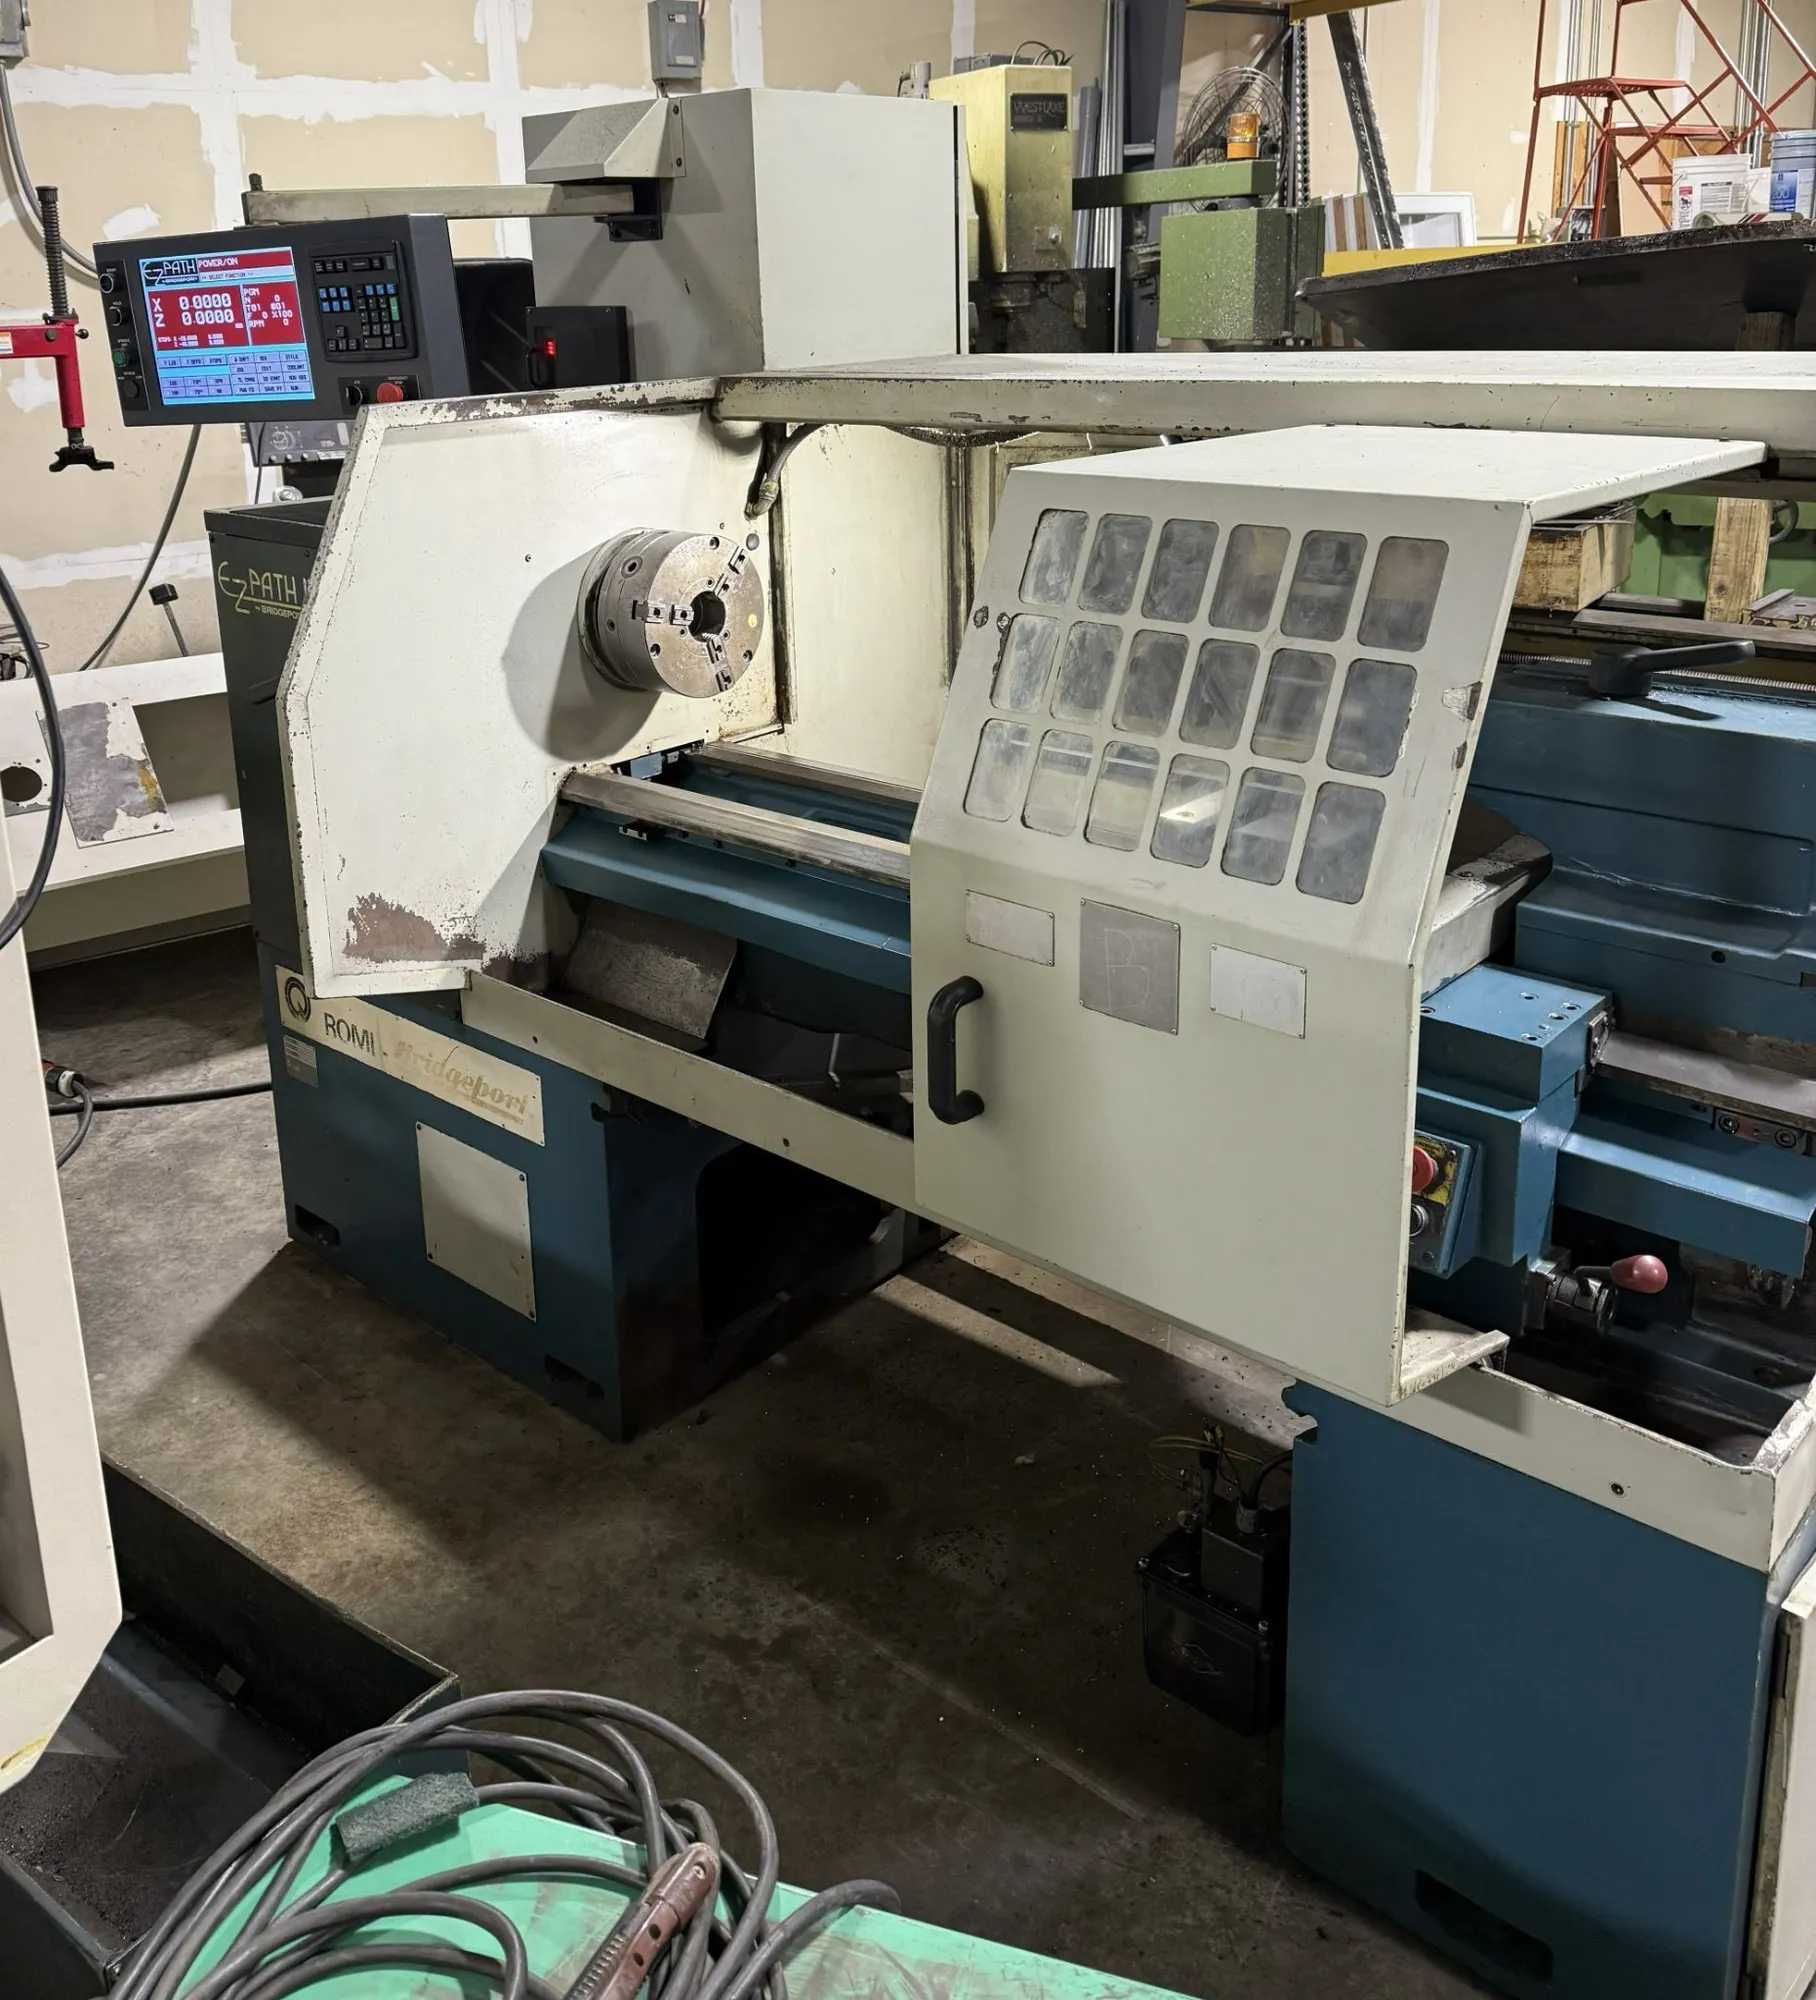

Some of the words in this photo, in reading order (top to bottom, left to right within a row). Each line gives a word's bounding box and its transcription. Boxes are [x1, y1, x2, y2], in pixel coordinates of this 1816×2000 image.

[152, 298, 162, 312] X
[179, 293, 232, 310] 0.0000
[155, 314, 166, 327] Z
[181, 309, 234, 326] 0.0000
[248, 568, 298, 604] PATH
[323, 1012, 375, 1057] ROMI
